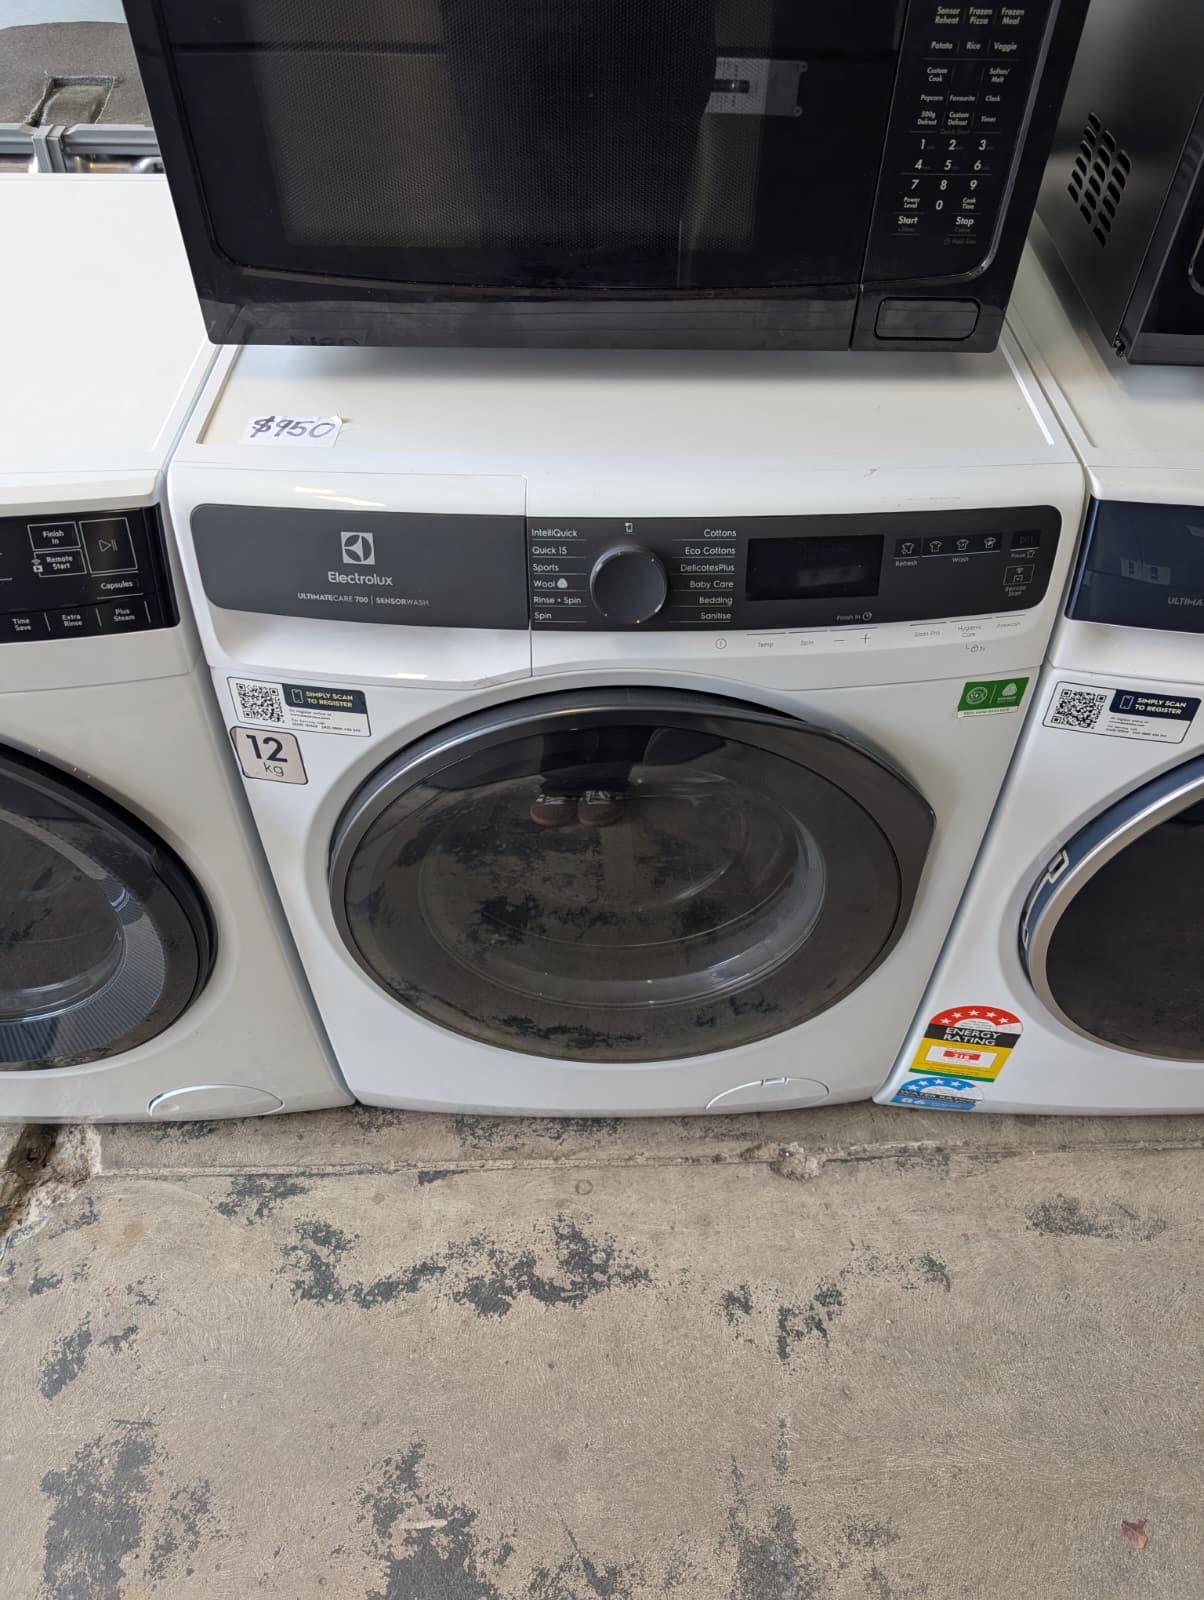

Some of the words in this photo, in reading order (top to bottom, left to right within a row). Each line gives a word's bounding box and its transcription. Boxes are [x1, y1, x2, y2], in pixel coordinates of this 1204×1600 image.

[937, 6, 960, 15] Sensor
[969, 7, 992, 15] Frozen
[1001, 8, 1024, 16] Frozen
[934, 16, 959, 25] Reheat
[969, 17, 989, 25] Pizza
[1001, 17, 1020, 25] Meal
[931, 41, 953, 50] Potato
[966, 41, 982, 50] Rice
[993, 42, 1018, 53] Veggie
[927, 67, 948, 75] Custom
[917, 118, 938, 126] Defrost
[920, 139, 926, 150] 1
[948, 139, 957, 151] 2
[978, 139, 987, 151] 3
[914, 159, 923, 170] 4
[944, 160, 953, 171] 5
[973, 160, 983, 171] 6
[911, 179, 920, 190] 7
[939, 179, 948, 191] 8
[969, 179, 978, 191] 9
[935, 199, 944, 211] 0
[898, 216, 919, 225] Start
[955, 216, 975, 228] Stop
[250, 415, 336, 438] $950
[42, 530, 65, 538] Finish
[531, 528, 579, 537] IntelliQuick
[703, 529, 737, 537] Cottons
[532, 546, 557, 555] Quick
[559, 546, 568, 554] 15
[685, 546, 702, 554] Eco
[705, 546, 736, 554] Cottons
[46, 556, 73, 564] Remote
[895, 559, 918, 567] Refresh
[53, 563, 71, 571] Start
[533, 563, 560, 573] Sports
[680, 563, 736, 572] DelicatesPlus
[327, 571, 393, 586] Electrolux
[101, 581, 134, 591] Capsules
[533, 580, 557, 588] Wool
[690, 580, 711, 591] Baby
[714, 579, 735, 588] Care
[297, 592, 353, 603] ULTIMATECARE
[354, 596, 370, 604] 700
[376, 597, 430, 606] SENSORWASH
[533, 596, 556, 604] Rinse
[564, 596, 582, 607] Spin
[699, 596, 734, 607] Bedding
[116, 608, 130, 617] Plus
[534, 611, 552, 621] Spin
[700, 611, 732, 620] Sanitise
[12, 617, 30, 625] Time
[62, 614, 81, 623] Extra
[113, 614, 135, 623] Steam
[15, 624, 32, 632] Save
[64, 620, 83, 628] Rinse
[305, 691, 332, 700] SIMPLY
[332, 693, 354, 701] SCAN
[319, 699, 353, 708] REGISTER
[1137, 697, 1164, 706] SIMPLY
[1165, 700, 1187, 708] SCAN
[1146, 705, 1182, 715] REGISTER
[246, 734, 288, 763] 12
[264, 762, 285, 777] kg
[946, 1027, 1000, 1039] ENERGY
[943, 1035, 996, 1046] RATING
